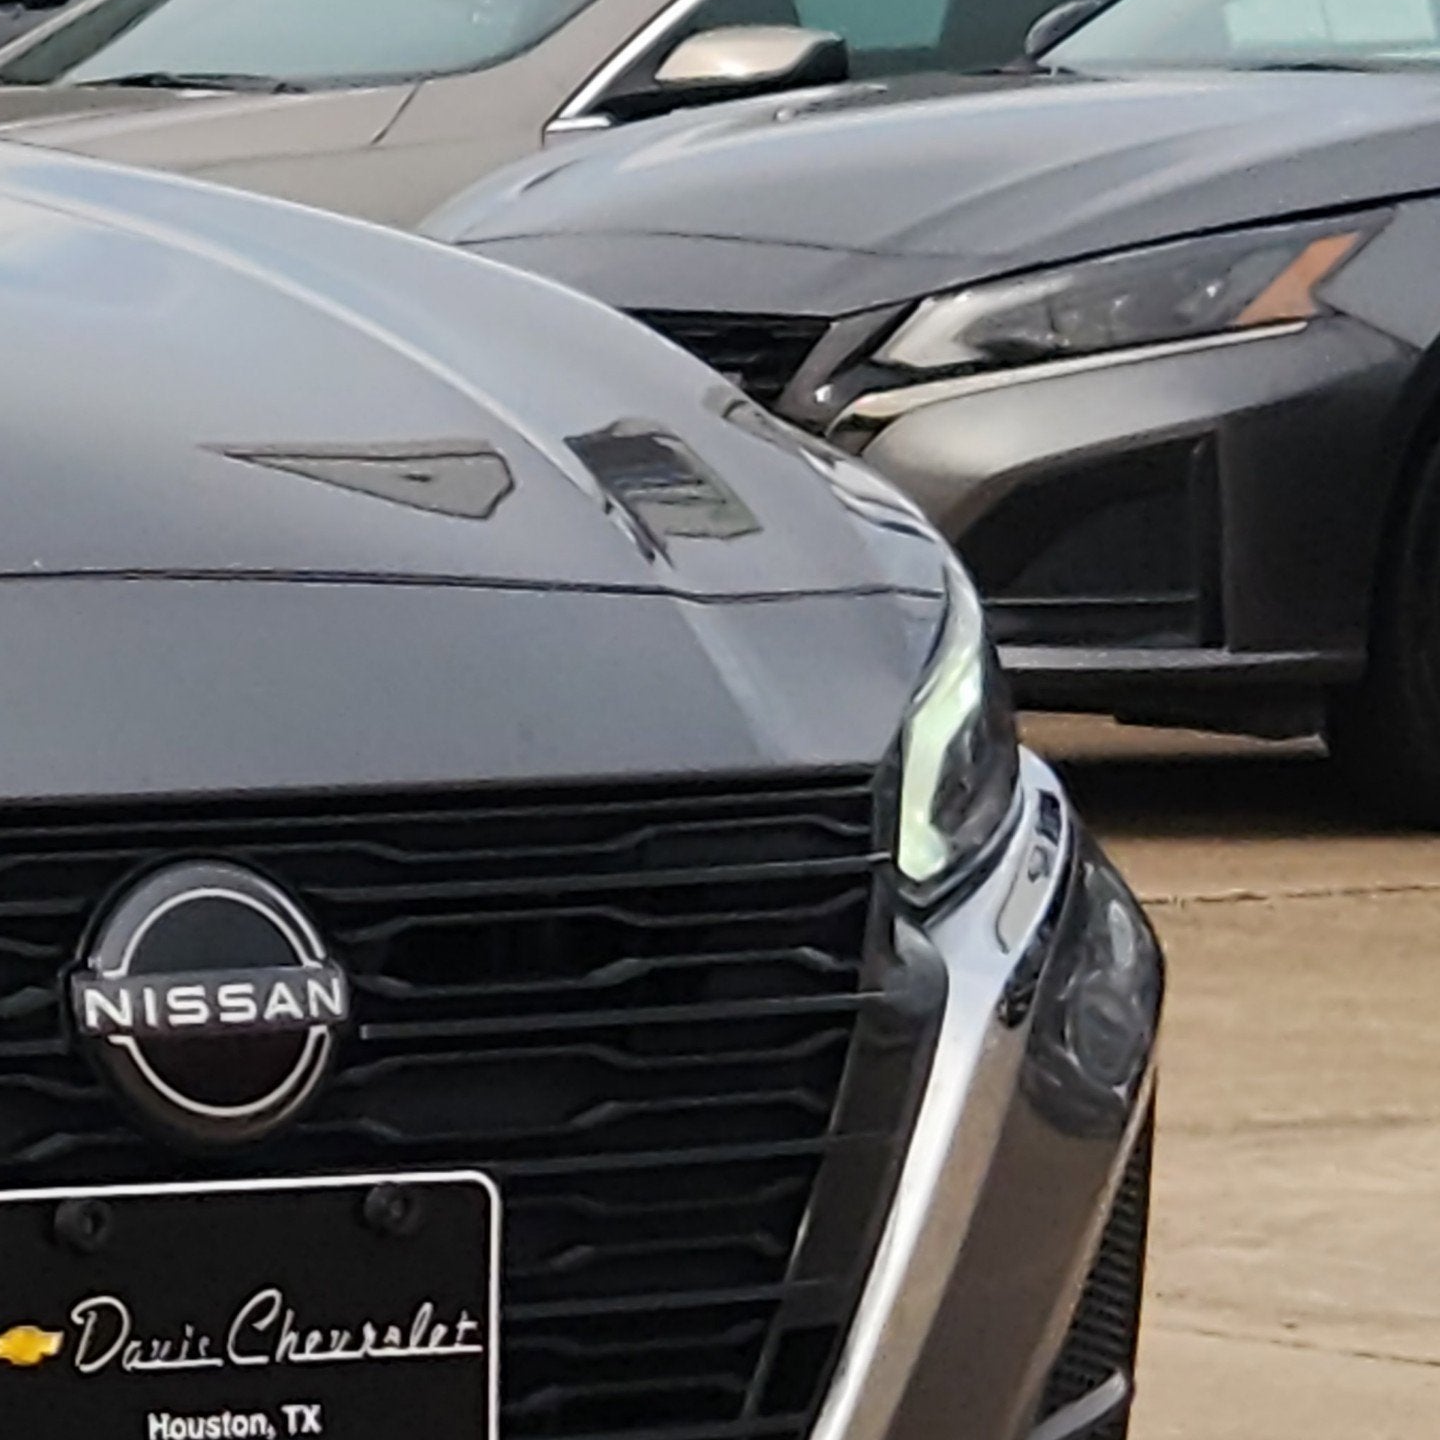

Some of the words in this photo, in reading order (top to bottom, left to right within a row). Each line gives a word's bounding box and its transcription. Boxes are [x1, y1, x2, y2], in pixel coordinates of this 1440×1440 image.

[84, 978, 342, 1029] NISSAN
[70, 1295, 224, 1373] Davis
[227, 1288, 484, 1364] Chevrolet
[281, 1404, 322, 1435] TX
